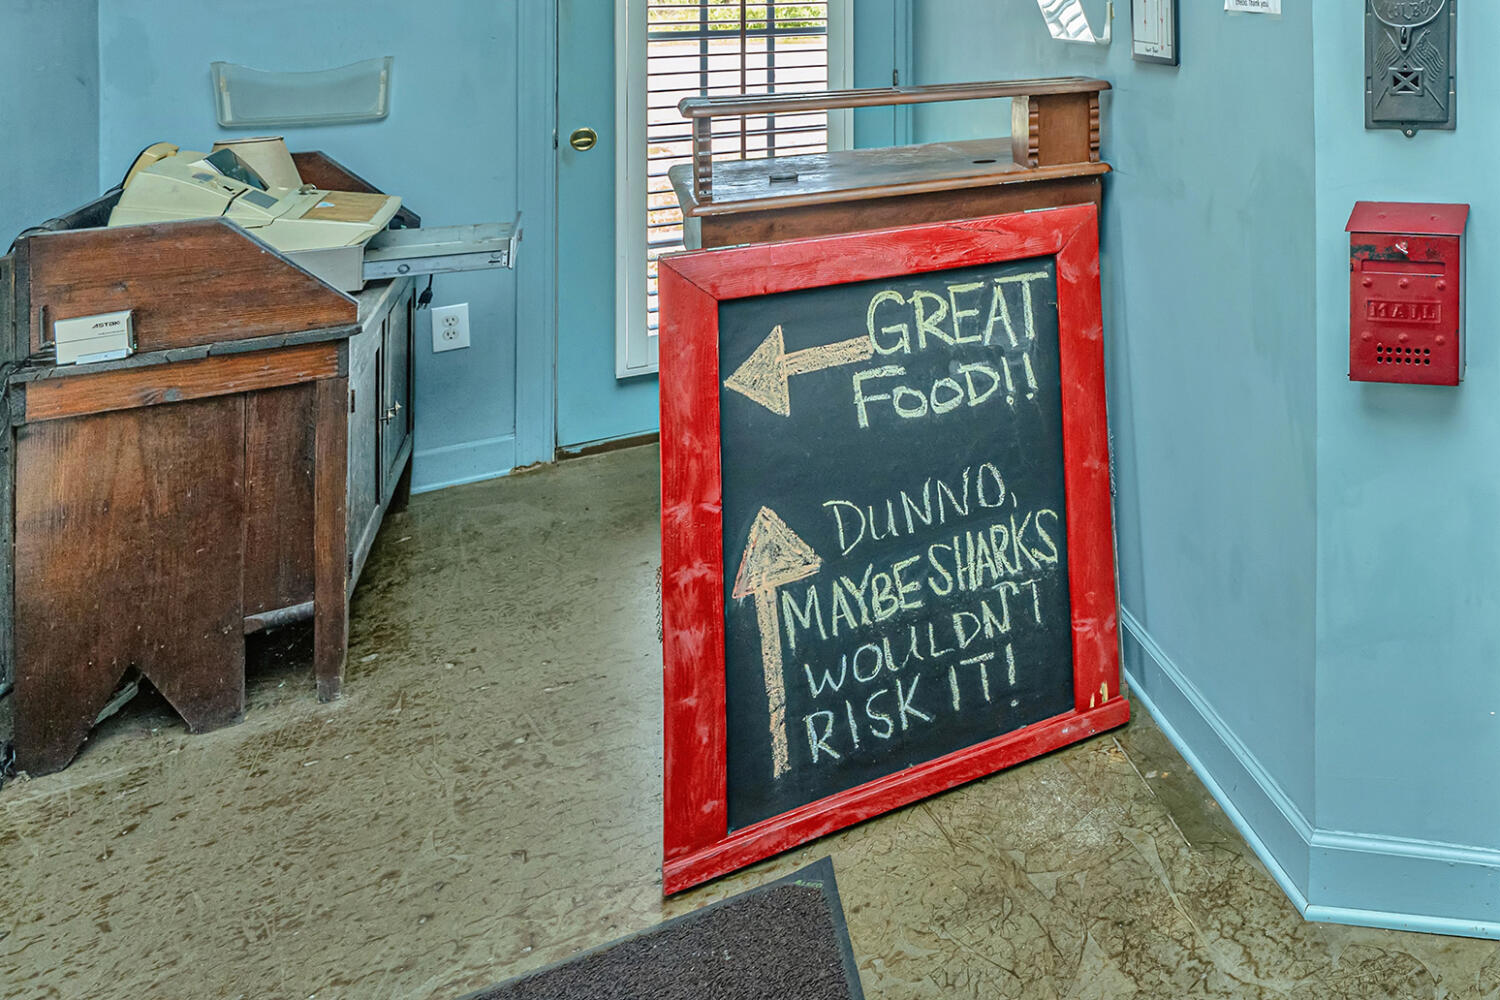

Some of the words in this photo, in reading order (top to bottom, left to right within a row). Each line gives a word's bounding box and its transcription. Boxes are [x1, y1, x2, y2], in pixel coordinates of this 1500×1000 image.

[866, 270, 1049, 361] GREAT
[1369, 302, 1436, 319] MAIL
[781, 557, 924, 650] MAYBE
[927, 508, 1060, 598] SHARKS
[804, 676, 939, 764] RISK
[948, 642, 1019, 709] IT!
